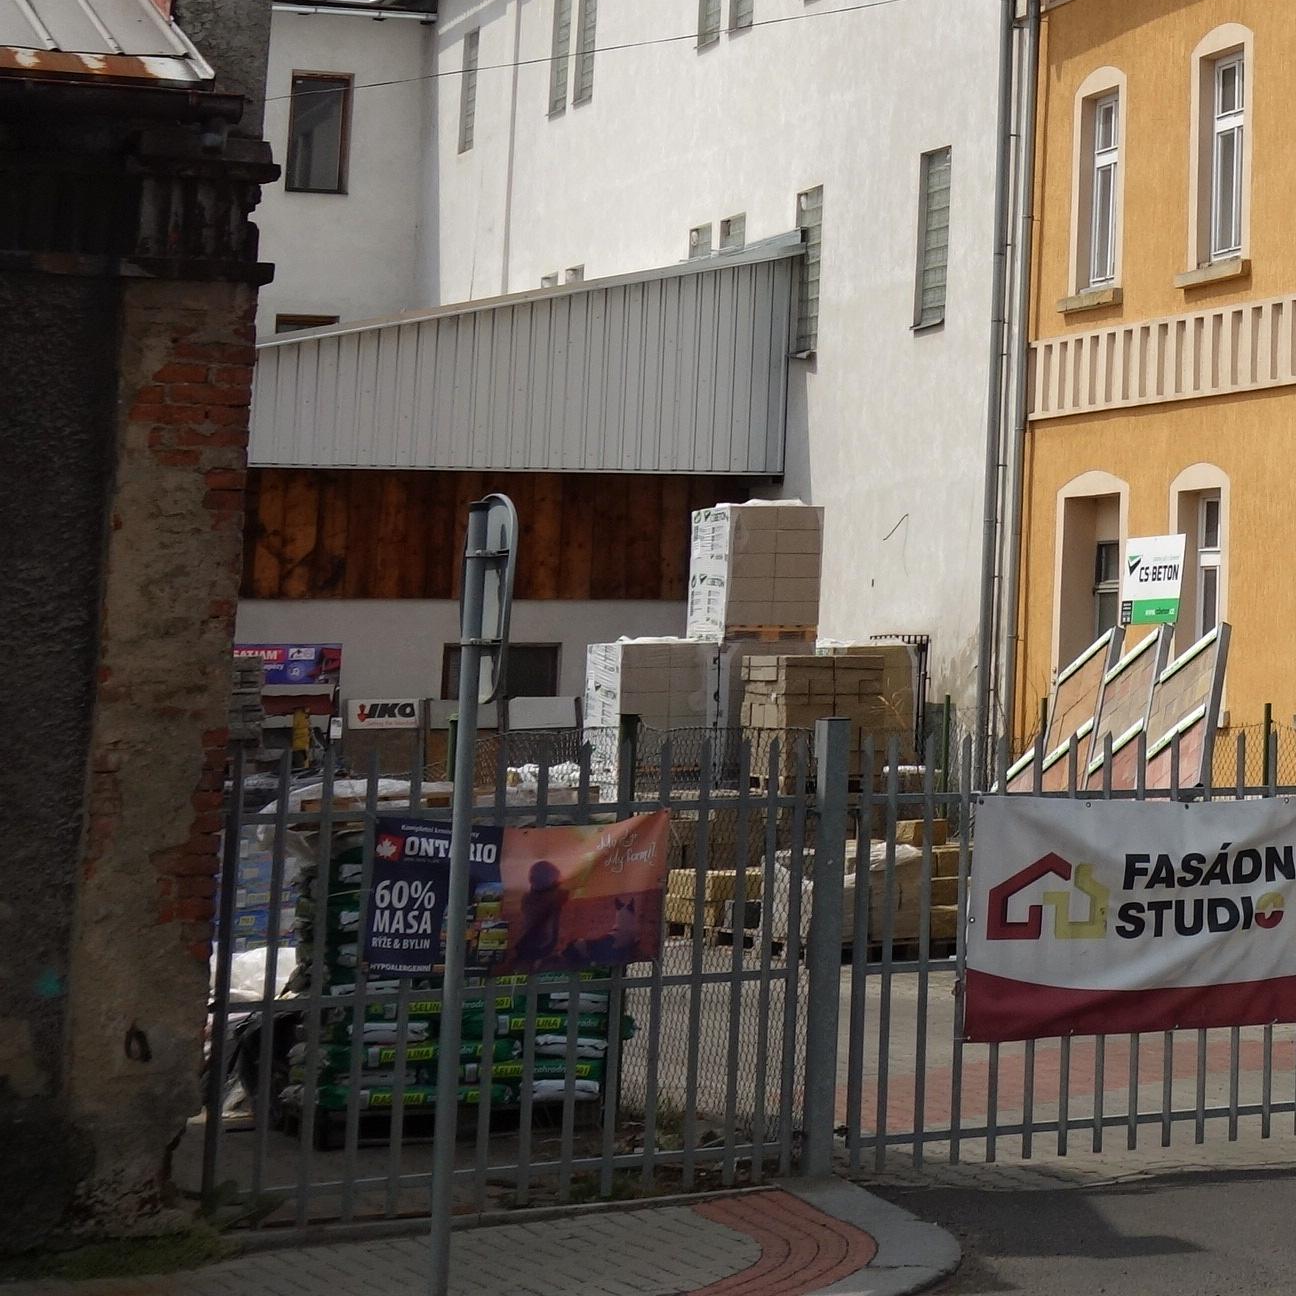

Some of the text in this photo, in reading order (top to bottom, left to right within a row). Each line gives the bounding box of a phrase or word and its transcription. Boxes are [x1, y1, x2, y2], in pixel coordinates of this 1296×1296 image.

[366, 703, 415, 718] IKO
[405, 836, 497, 864] ONTRIO
[375, 880, 436, 909] 60%
[373, 909, 431, 934] MASA
[1116, 891, 1285, 939] STUDIO
[394, 939, 400, 949] &
[402, 939, 430, 949] BYLIN
[512, 1017, 561, 1029] RALINA
[382, 1047, 432, 1062] RALINA
